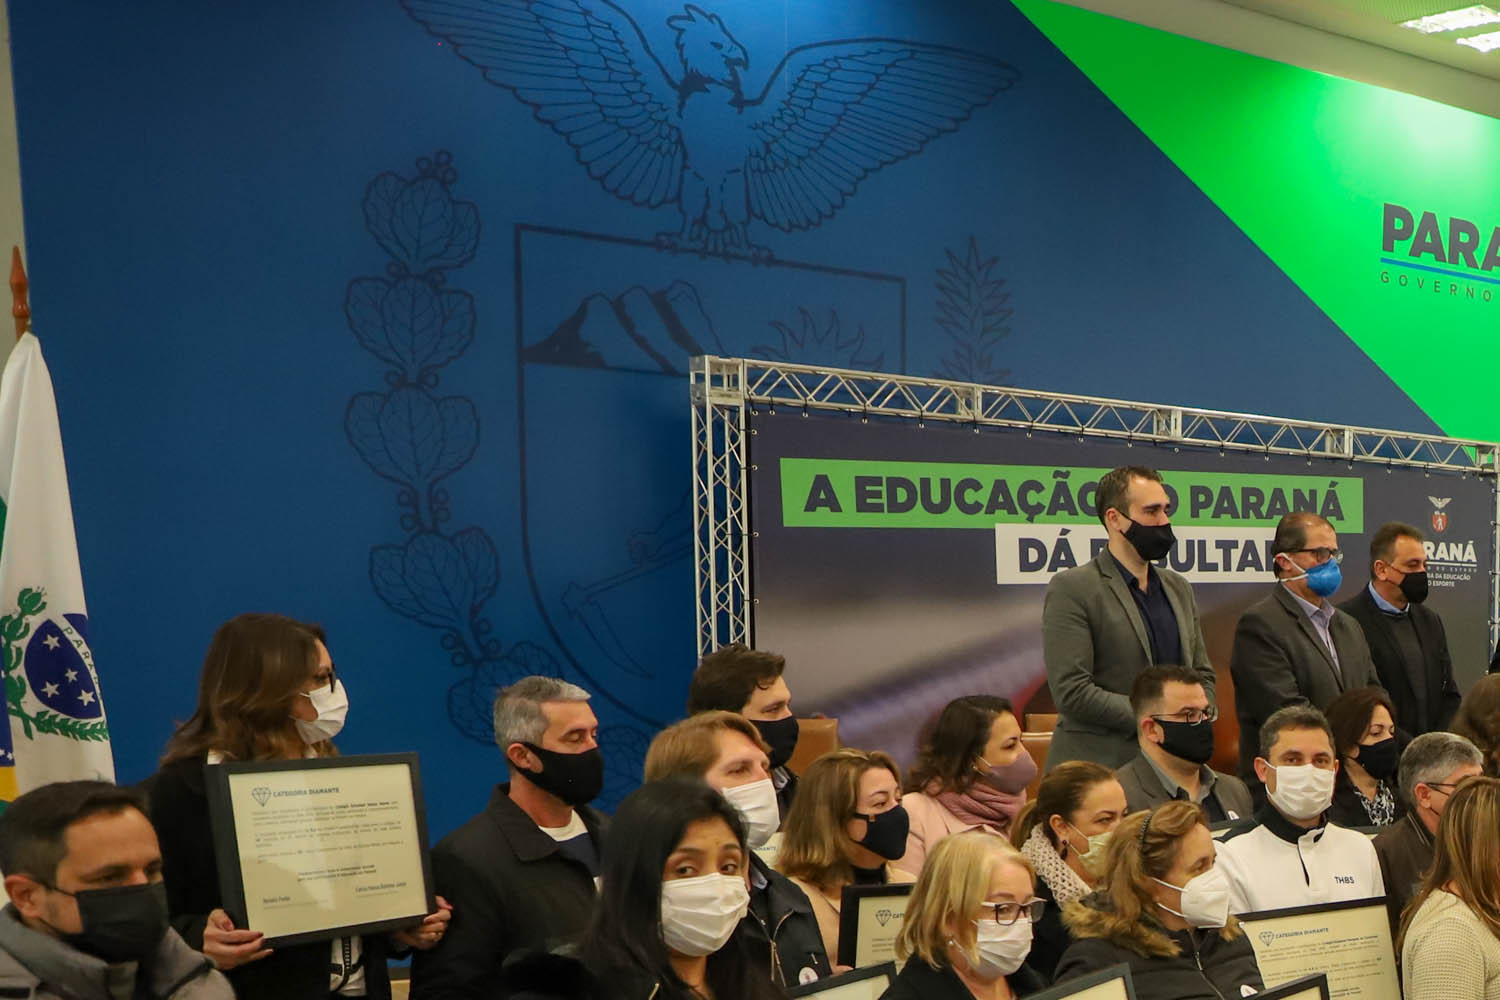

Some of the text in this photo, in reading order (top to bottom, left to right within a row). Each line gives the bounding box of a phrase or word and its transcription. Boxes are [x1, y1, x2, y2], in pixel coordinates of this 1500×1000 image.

[1380, 271, 1492, 301] GOVERNO
[804, 474, 843, 513] A
[855, 470, 1101, 522] EDUCAÇÃO
[1190, 480, 1344, 521] PARANÁ
[1018, 528, 1077, 573] DÁ
[1423, 540, 1477, 562] RANÁ
